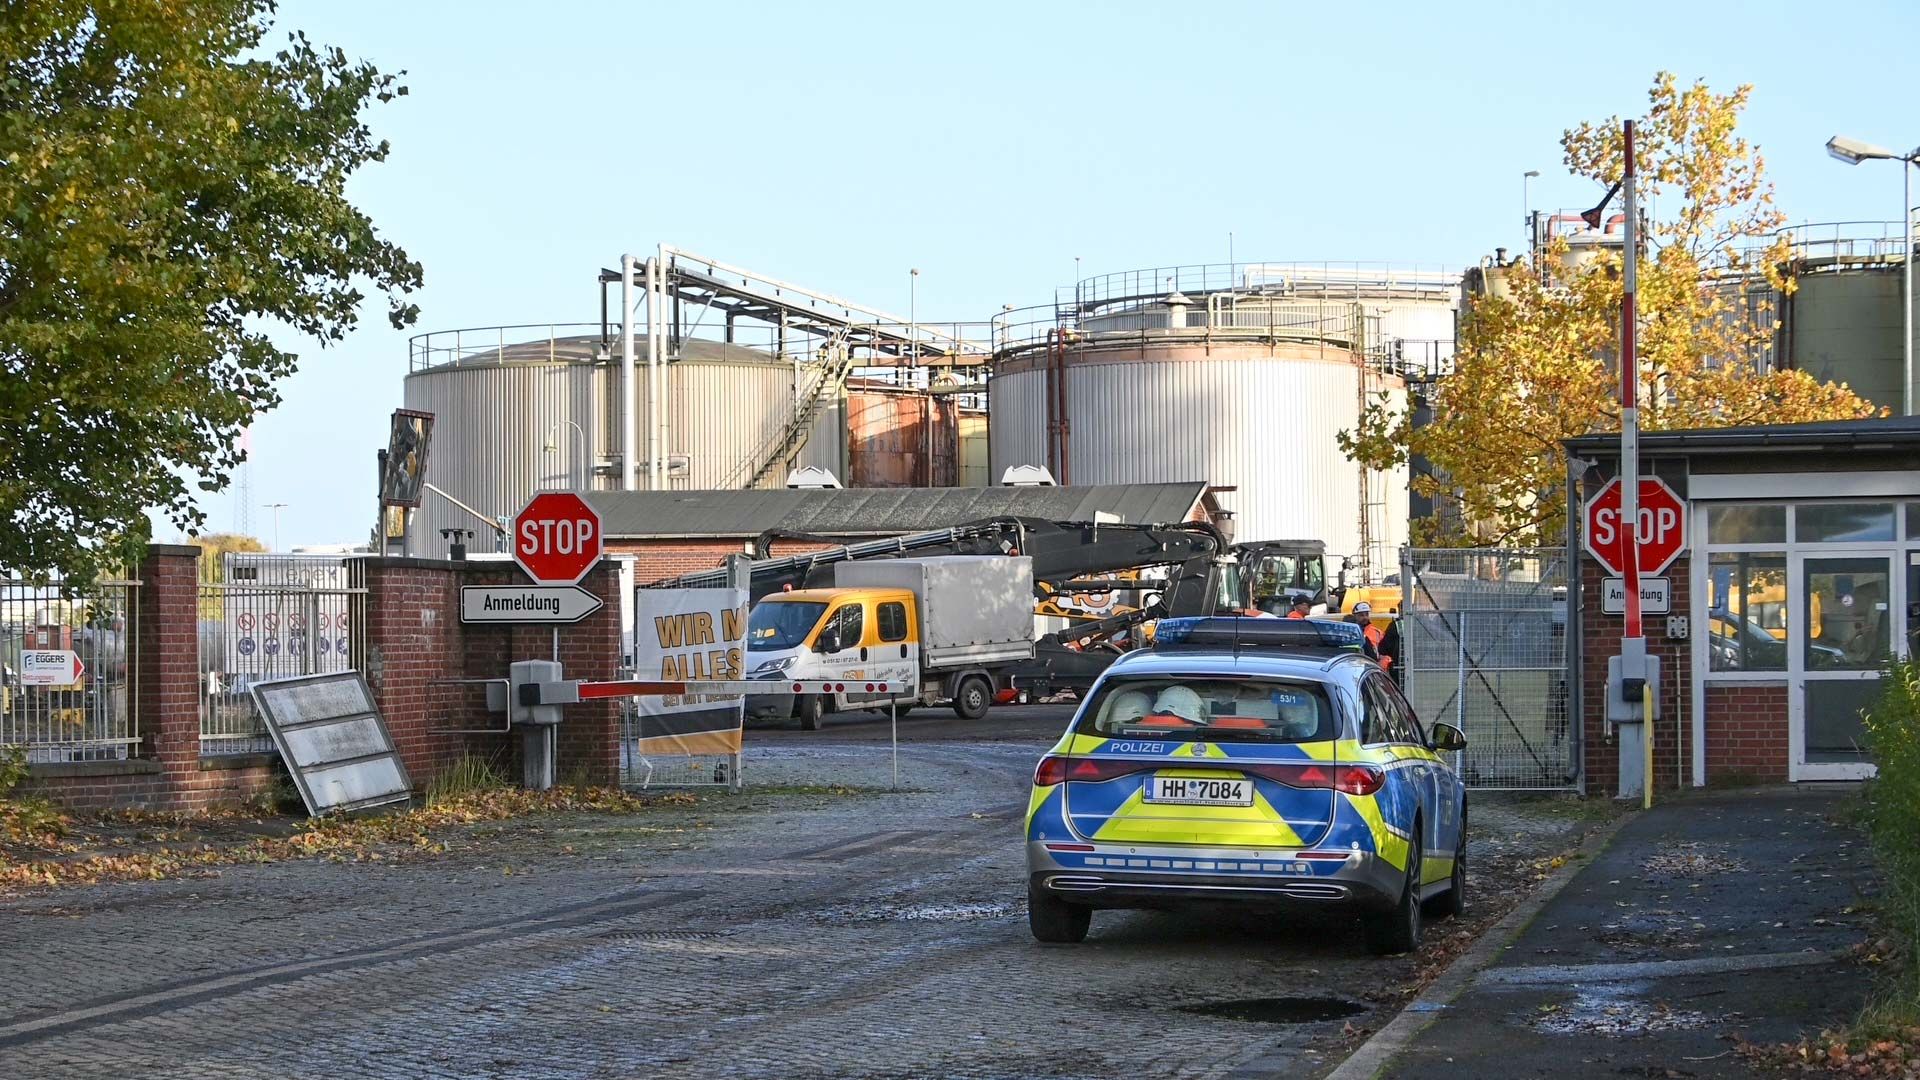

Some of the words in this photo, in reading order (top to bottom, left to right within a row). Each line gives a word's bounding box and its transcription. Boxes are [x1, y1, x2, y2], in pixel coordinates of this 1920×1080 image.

[521, 519, 593, 555] STOP
[484, 594, 560, 615] Anmeldung
[1610, 588, 1662, 602] Andung
[654, 611, 715, 649] WIR
[36, 655, 65, 663] EGGERS
[661, 648, 743, 681] ALLES
[1280, 694, 1296, 704] 53/1
[1110, 743, 1164, 753] POLIZEI
[1162, 780, 1186, 798] HH
[1199, 781, 1242, 800] 7084
